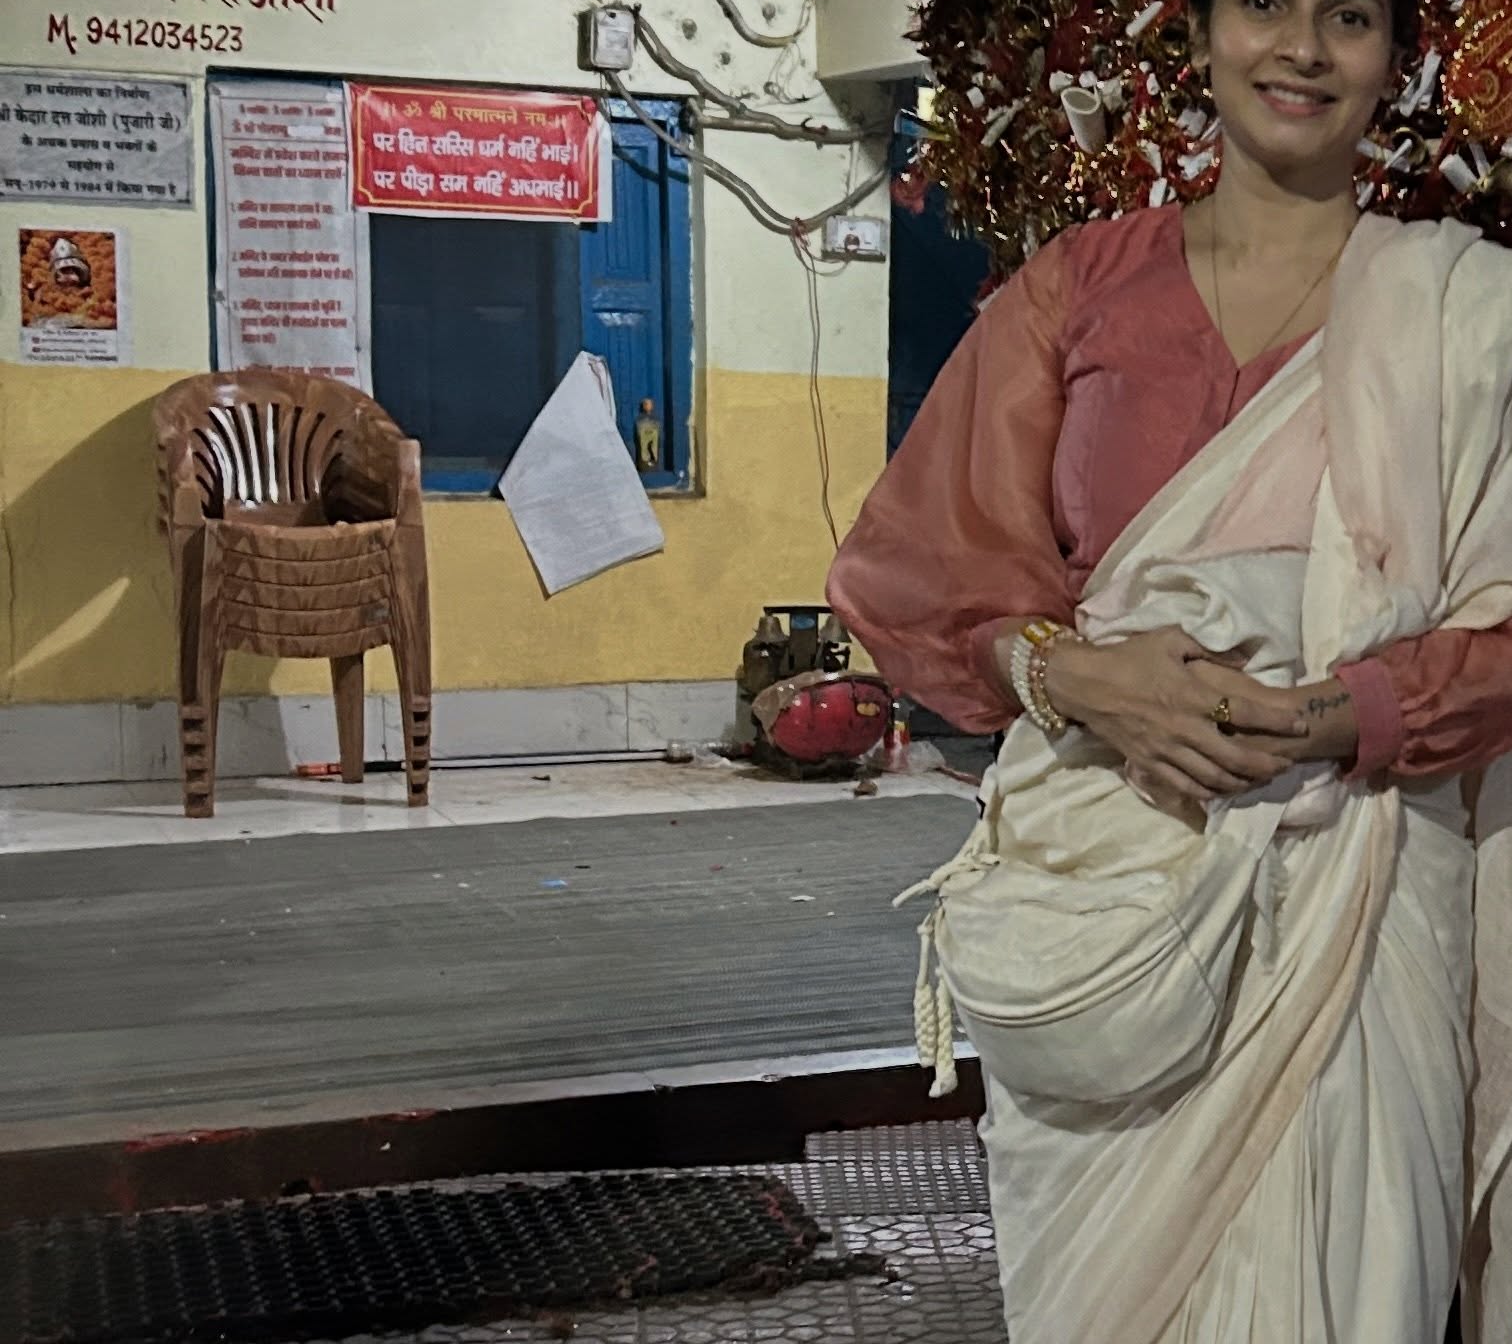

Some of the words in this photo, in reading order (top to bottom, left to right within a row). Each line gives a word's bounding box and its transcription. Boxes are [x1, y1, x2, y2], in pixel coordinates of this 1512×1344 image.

[47, 13, 77, 55] M.
[86, 16, 243, 52] 9412034523
[96, 87, 112, 97] का
[14, 103, 48, 125] केदार
[75, 107, 107, 127] जोशी
[430, 100, 447, 120] श्री
[452, 104, 518, 125] परमात्मने
[372, 132, 395, 154] पर
[398, 127, 429, 156] हित
[432, 130, 475, 157] सरिस
[478, 133, 505, 159] धर्म
[508, 136, 541, 163] नहिं
[373, 170, 396, 190] पर
[401, 165, 434, 197] पीड़ा
[439, 174, 468, 193] सम
[473, 170, 507, 197] नहिं
